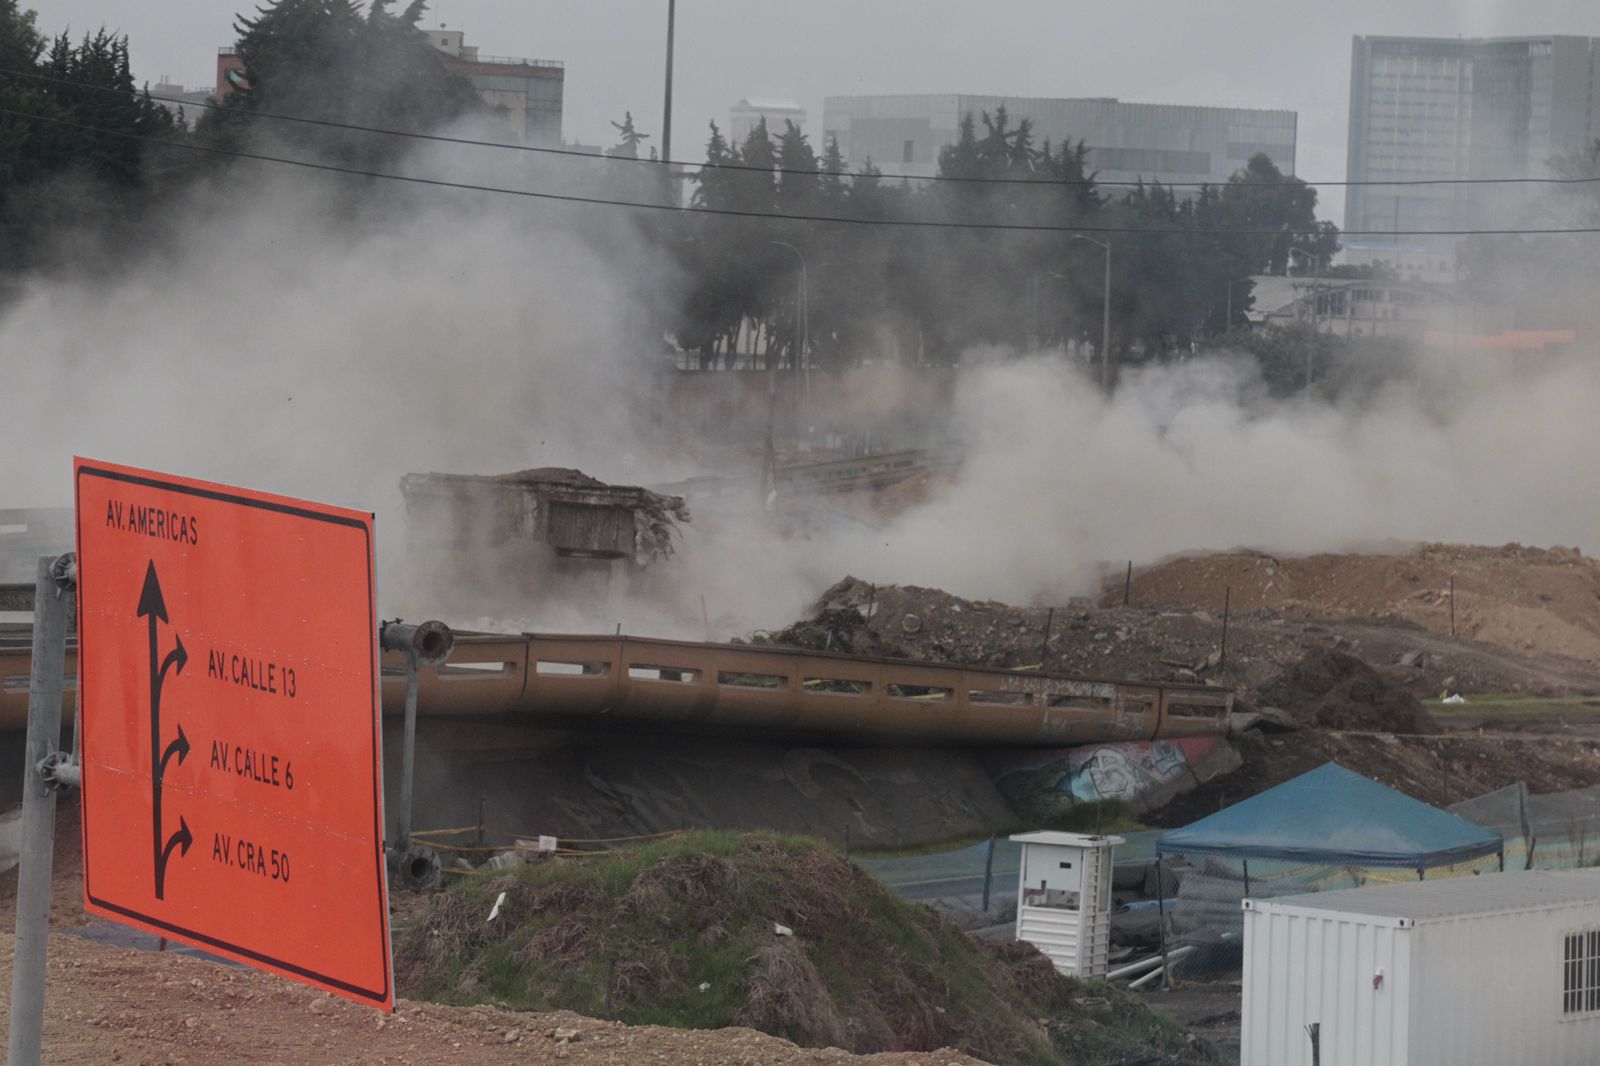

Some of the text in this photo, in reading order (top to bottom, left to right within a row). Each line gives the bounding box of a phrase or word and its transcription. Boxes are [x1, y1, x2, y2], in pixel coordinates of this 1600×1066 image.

[106, 500, 198, 546] AV. AMERICAS
[208, 650, 296, 698] AV. CALLE 13
[210, 740, 294, 790] AV. CALLE 6
[213, 832, 290, 883] AV. CRA 50
